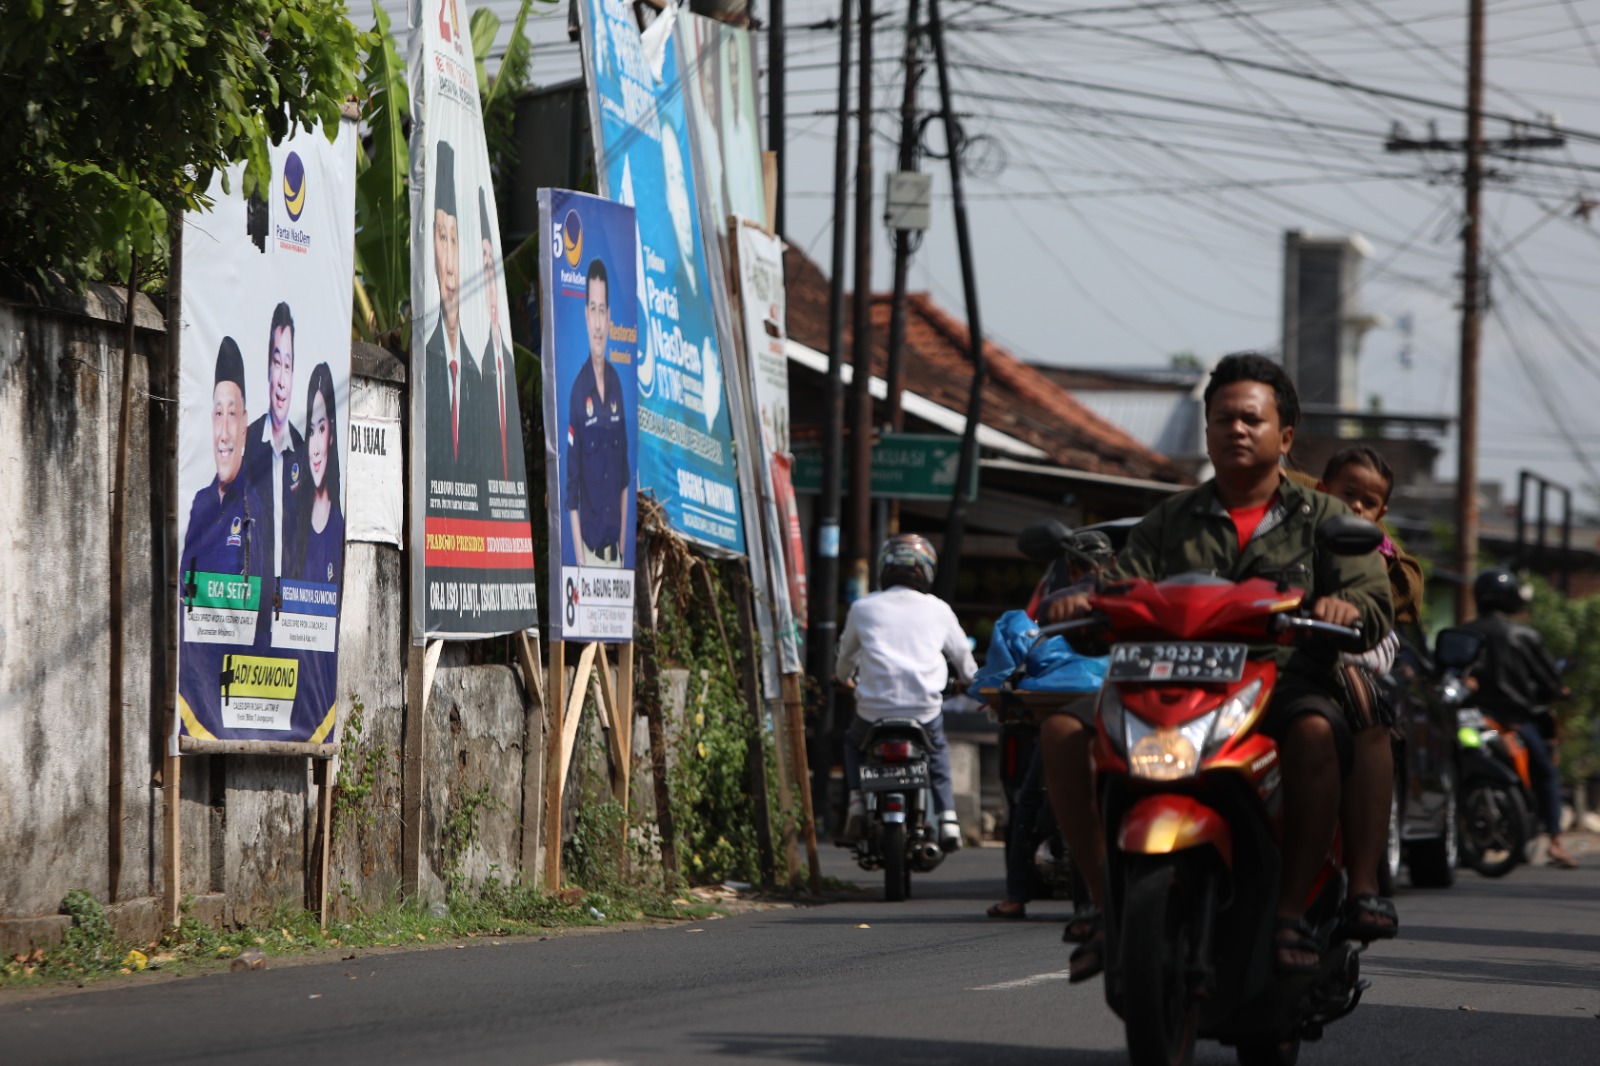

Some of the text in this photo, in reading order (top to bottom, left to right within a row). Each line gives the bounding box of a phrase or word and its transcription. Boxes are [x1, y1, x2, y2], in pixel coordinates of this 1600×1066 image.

[276, 224, 311, 245] Partai NasDem
[553, 222, 563, 258] 5
[646, 276, 679, 321] Partai
[609, 320, 638, 343] Restorasi
[651, 316, 702, 375] NasDem
[351, 424, 387, 456] DI JUAL
[430, 480, 455, 494] PRABOWO
[455, 481, 478, 497] SUBIANTO
[426, 534, 455, 551] PRABOWO
[456, 535, 485, 552] PRESIDEN
[207, 580, 225, 598] EKA
[282, 586, 299, 602] REGINA
[314, 590, 337, 606] SUWONO
[430, 581, 445, 611] ORA
[446, 582, 458, 611] ISO
[500, 583, 517, 611] MUNG
[593, 578, 611, 598] AGUNG
[612, 579, 632, 599] PRIBADI
[566, 576, 575, 628] 8
[1114, 645, 1141, 662] AG
[1212, 646, 1240, 663] XY
[251, 665, 295, 688] SUWONO
